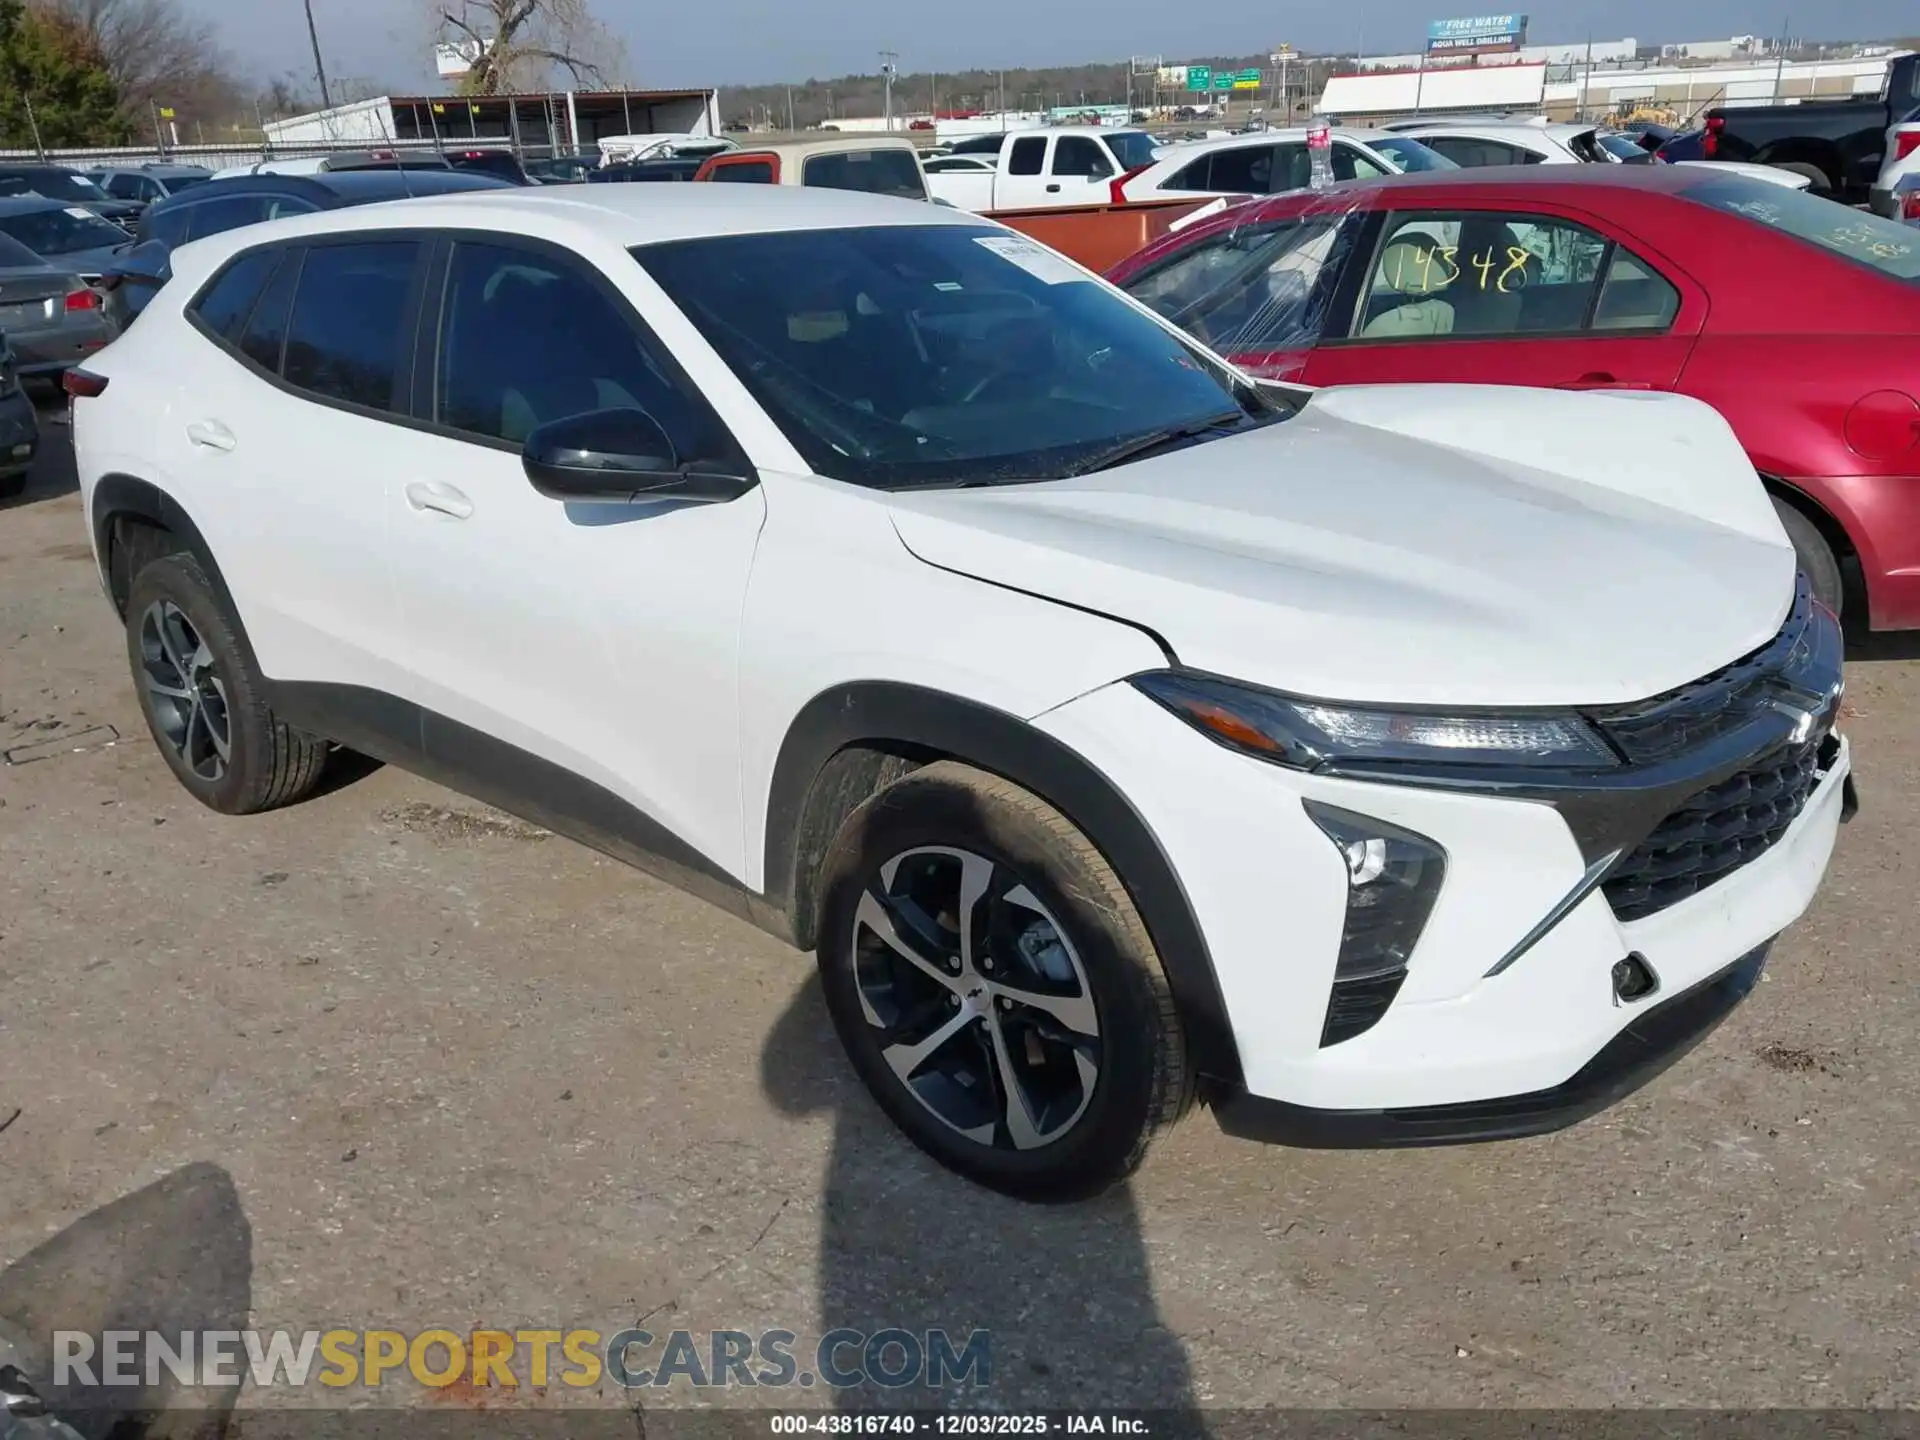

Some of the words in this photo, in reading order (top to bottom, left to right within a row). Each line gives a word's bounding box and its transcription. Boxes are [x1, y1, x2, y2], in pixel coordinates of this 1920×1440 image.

[1446, 19, 1473, 30] FREE
[1475, 15, 1512, 27] WATER
[1432, 39, 1454, 49] AQUA
[1455, 38, 1474, 48] WELL
[1476, 35, 1512, 46] DRILLING
[1395, 246, 1531, 293] 14348
